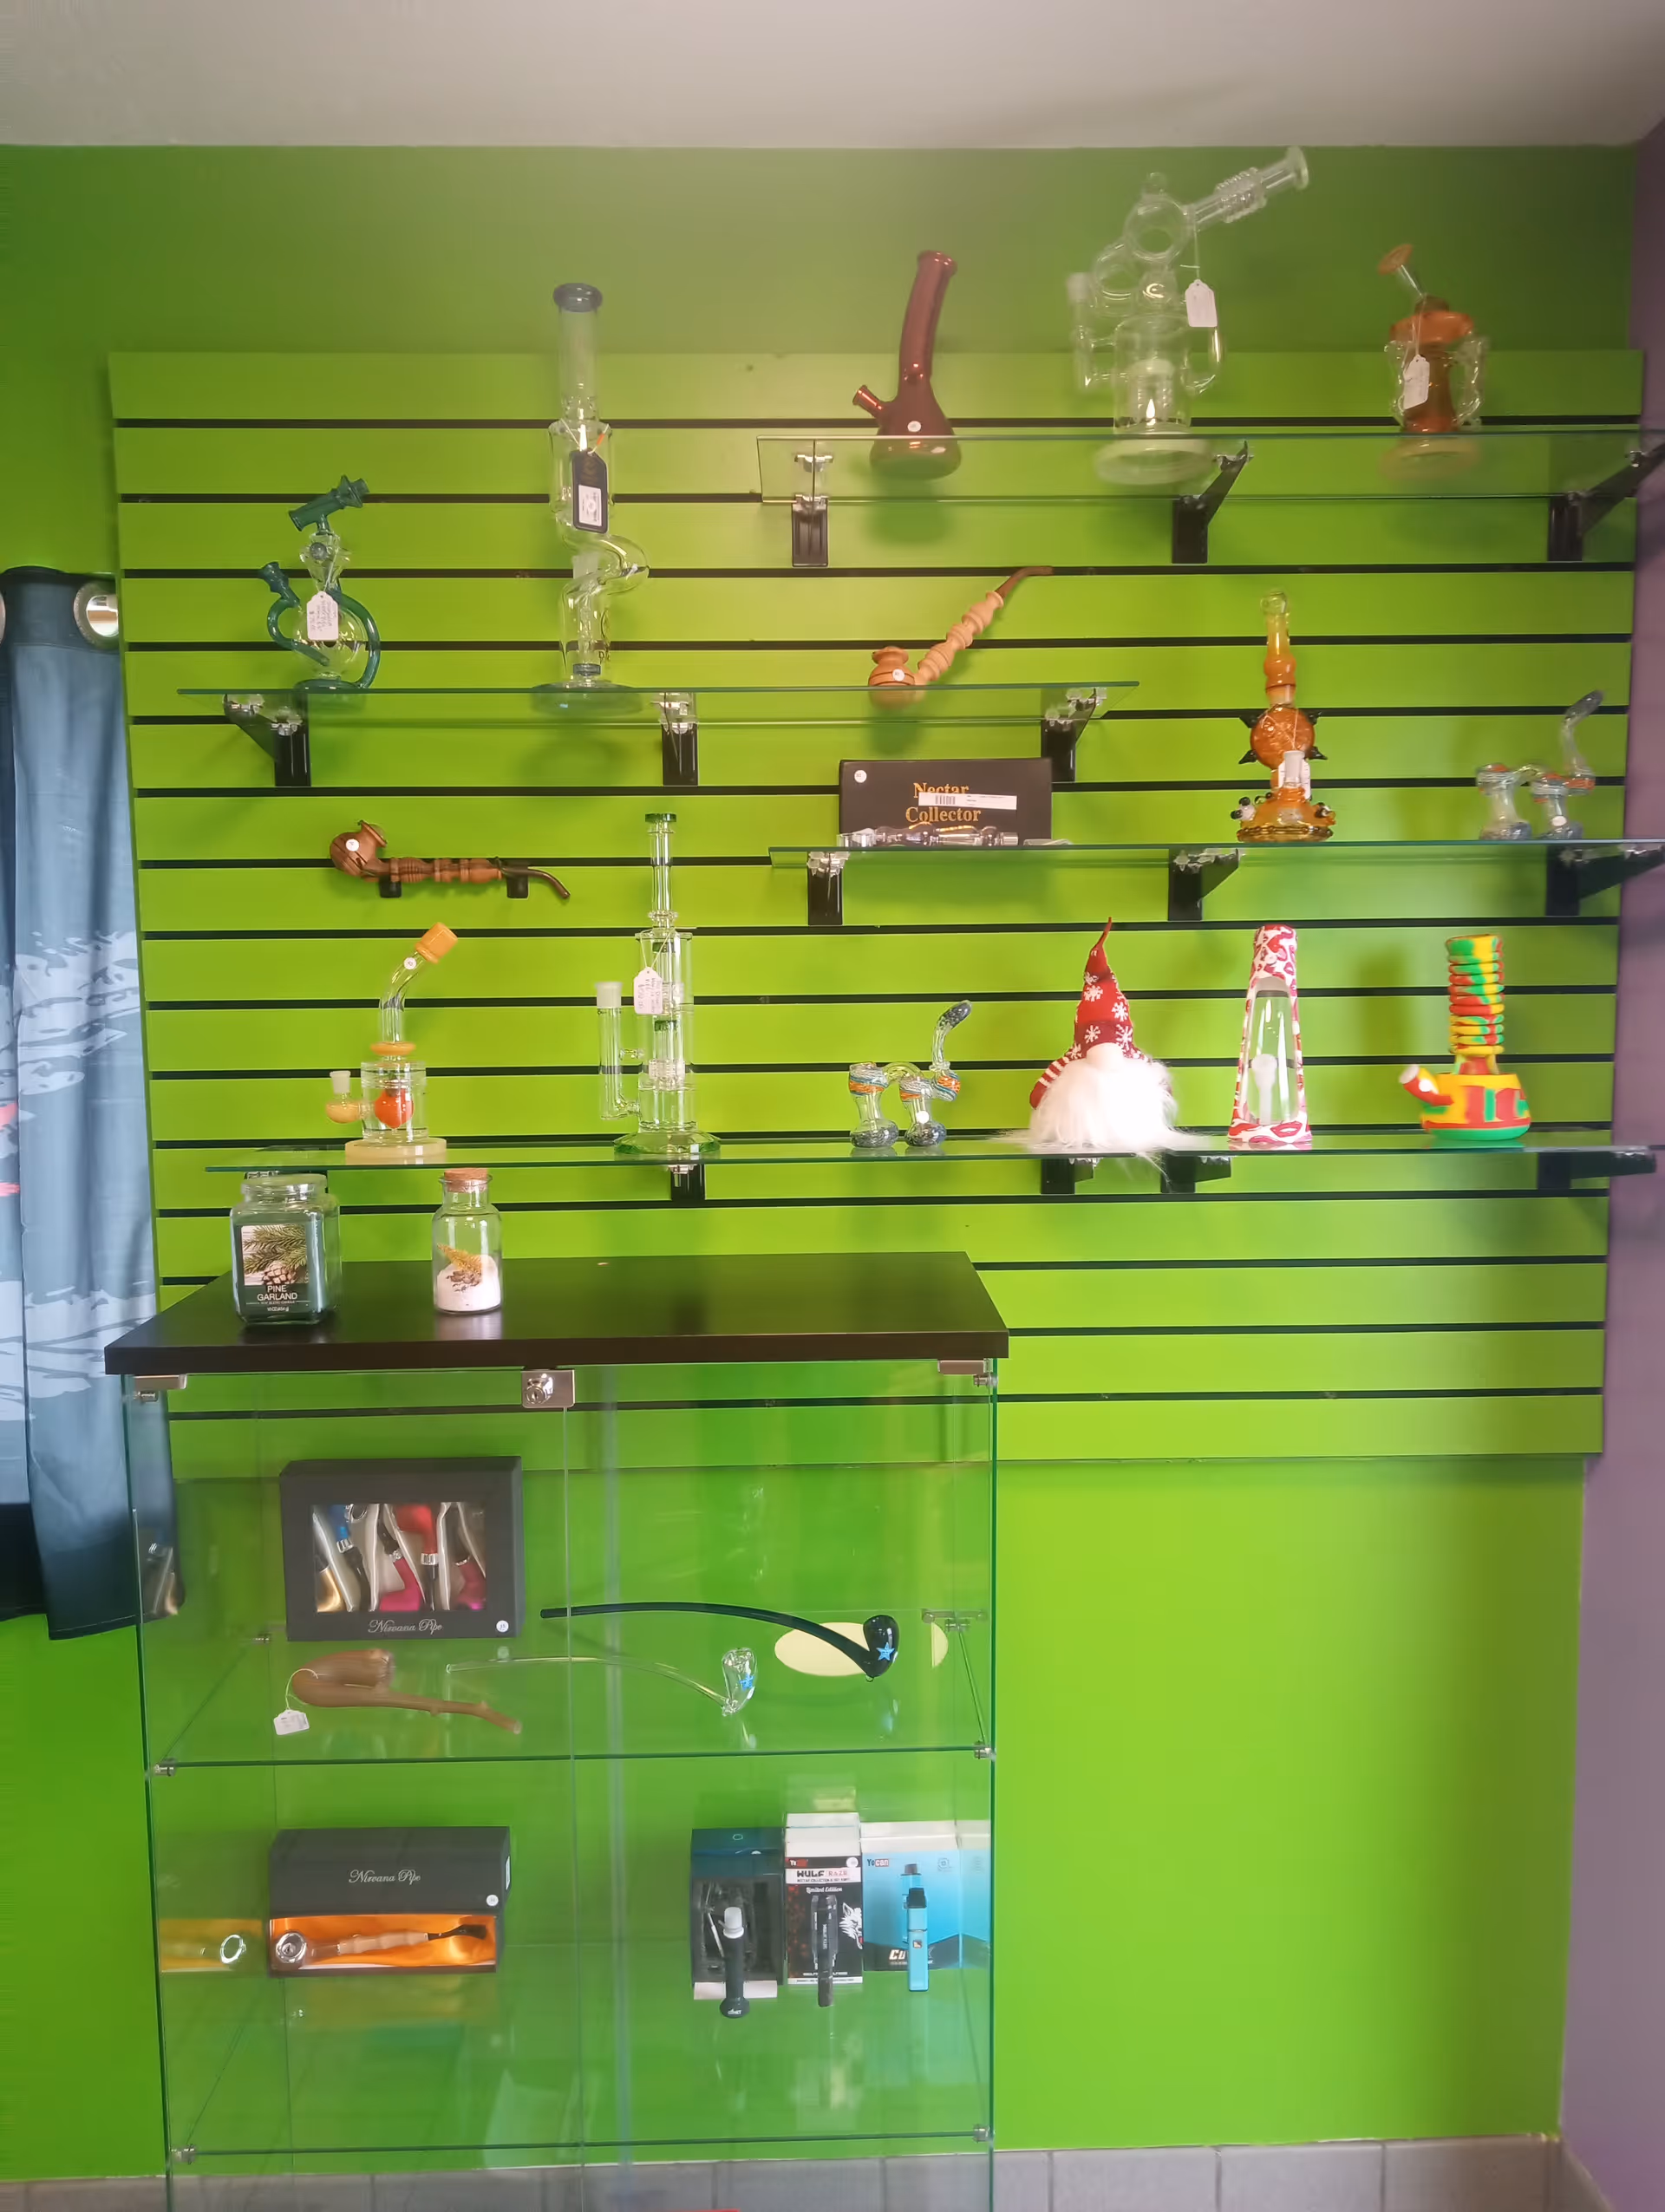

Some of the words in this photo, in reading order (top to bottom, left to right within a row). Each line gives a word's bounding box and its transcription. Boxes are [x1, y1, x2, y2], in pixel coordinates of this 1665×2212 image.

[913, 782, 970, 798] Nectar
[905, 806, 982, 823] Collector
[257, 1292, 298, 1301] GARLAND
[267, 1284, 287, 1293] PINE
[368, 1619, 416, 1633] Nirvana
[418, 1618, 443, 1635] Pipe
[867, 1858, 889, 1867] Yocan
[349, 1869, 395, 1883] Nirvana
[397, 1869, 421, 1885] Pipe
